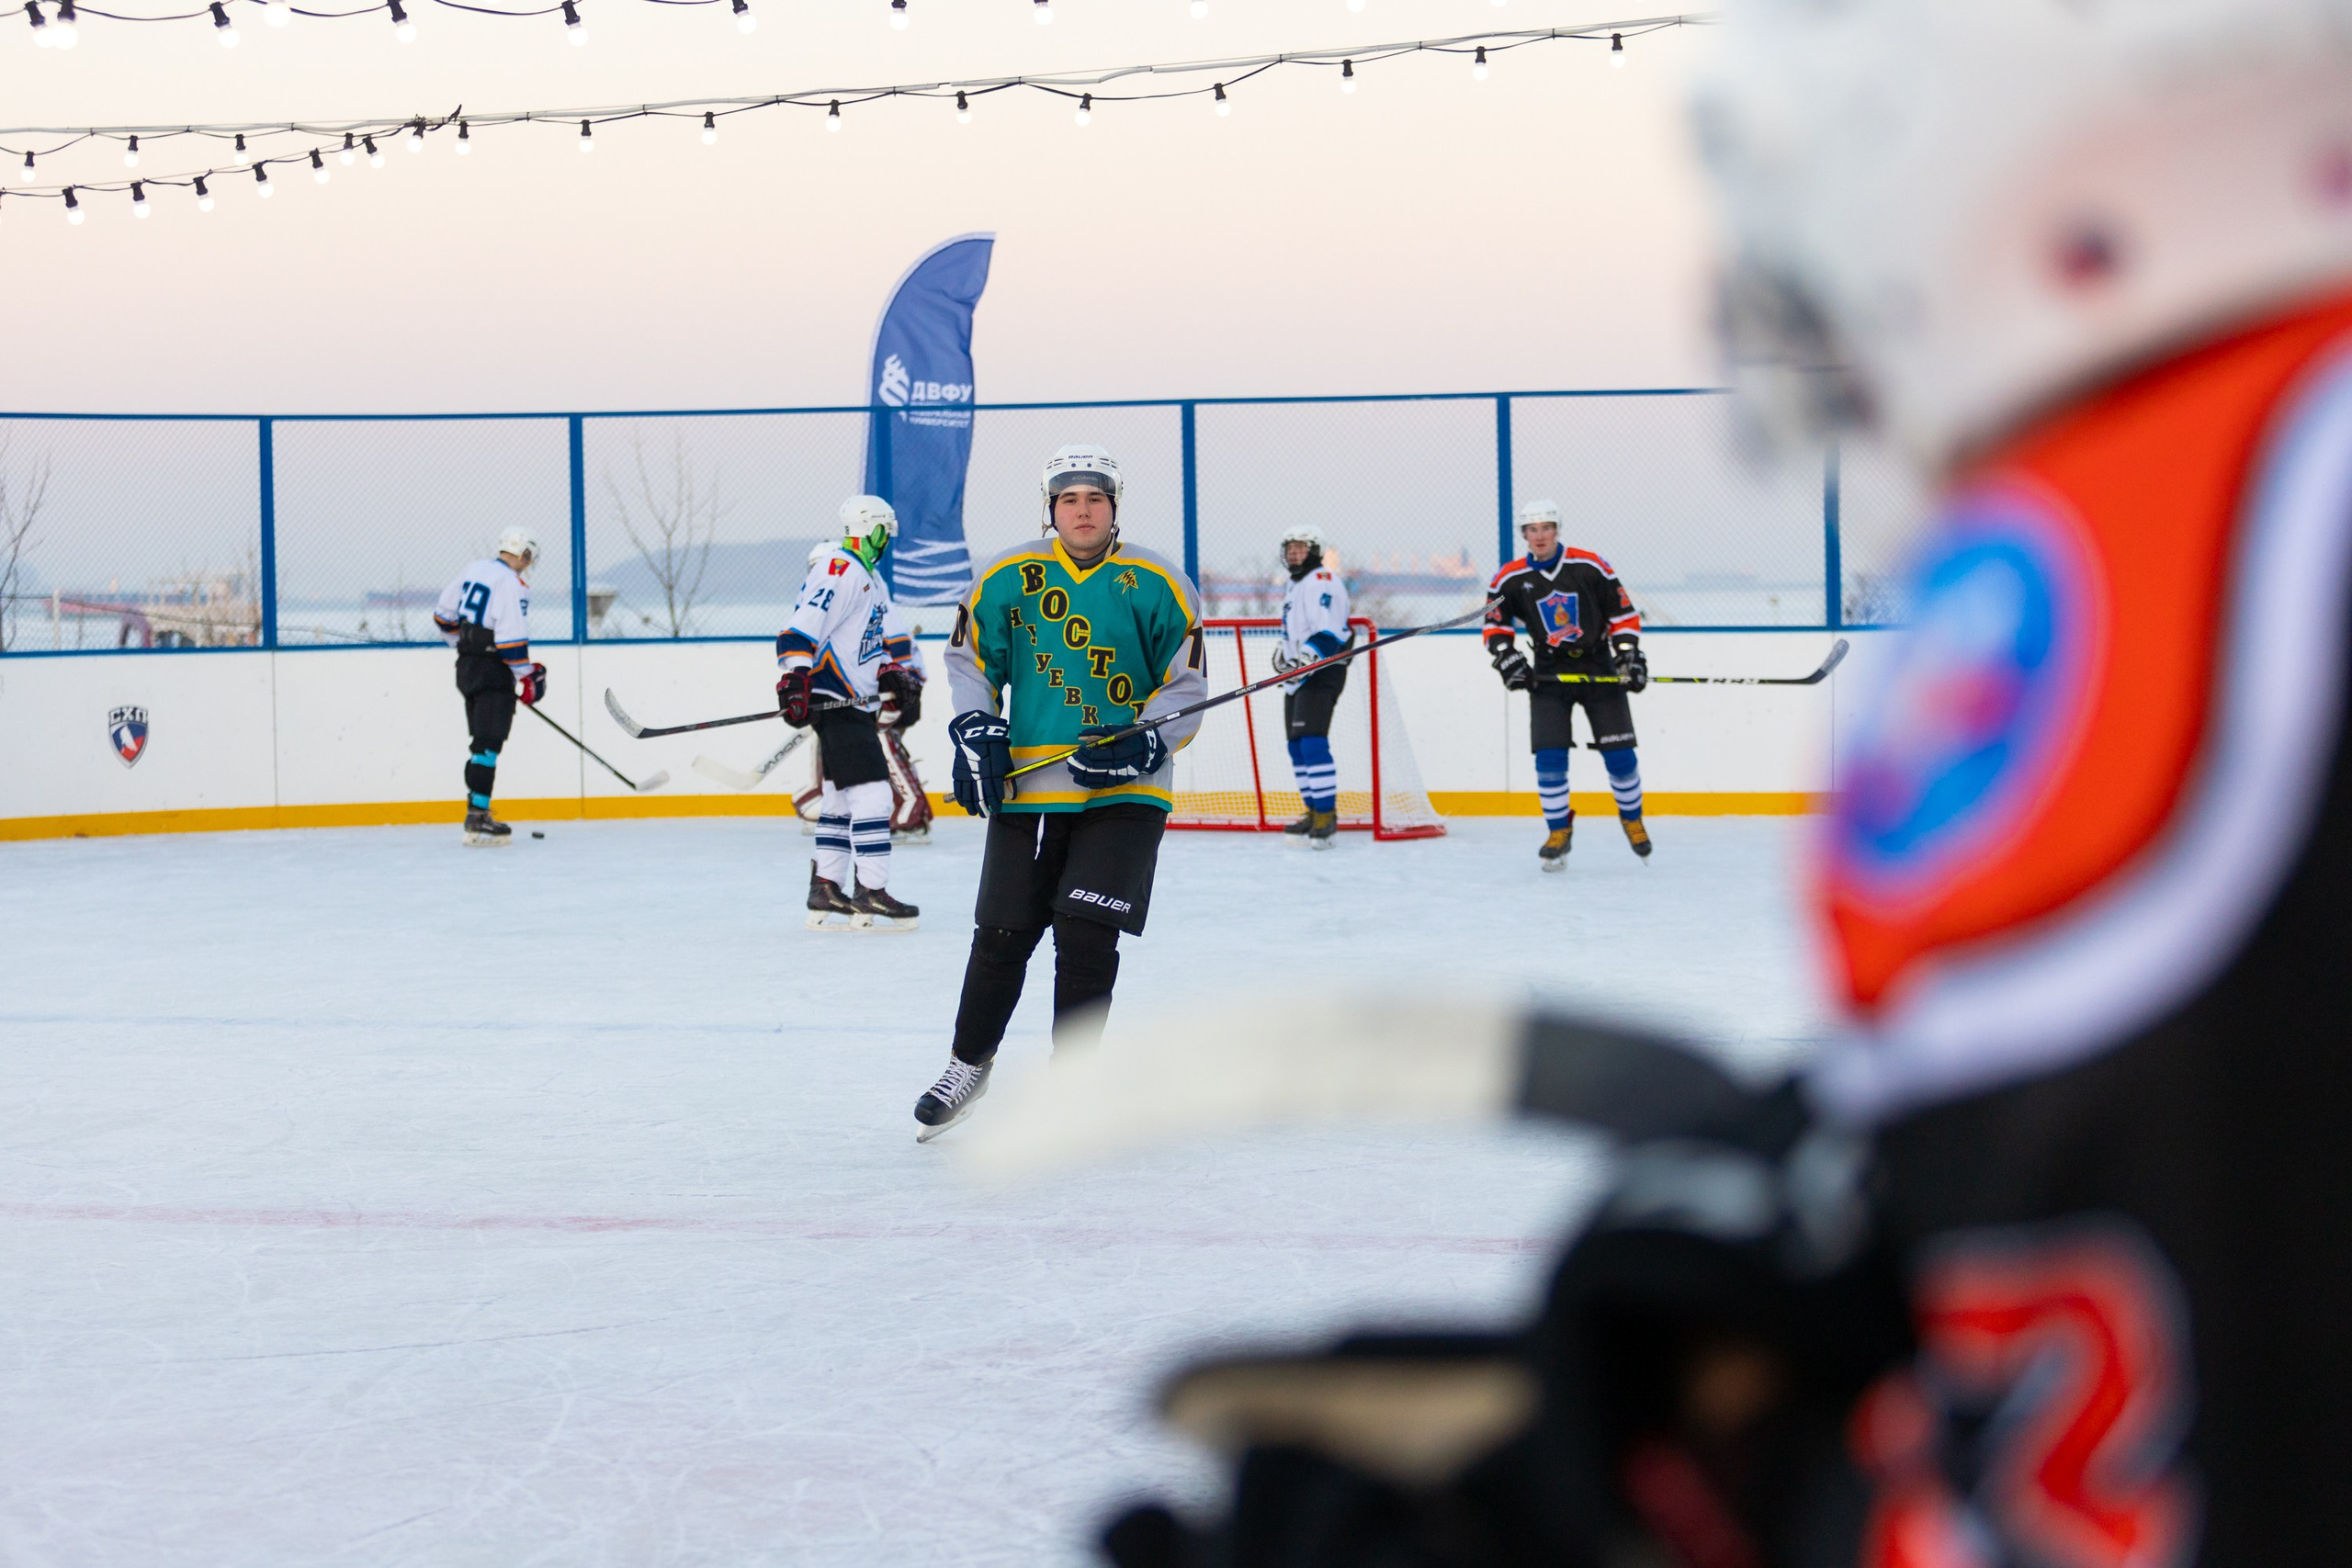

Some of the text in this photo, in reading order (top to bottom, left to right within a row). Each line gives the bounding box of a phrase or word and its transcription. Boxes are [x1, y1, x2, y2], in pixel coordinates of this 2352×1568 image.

[910, 381, 973, 403] ДВФУ
[964, 725, 1010, 739] CC
[1069, 889, 1131, 914] BAUER
